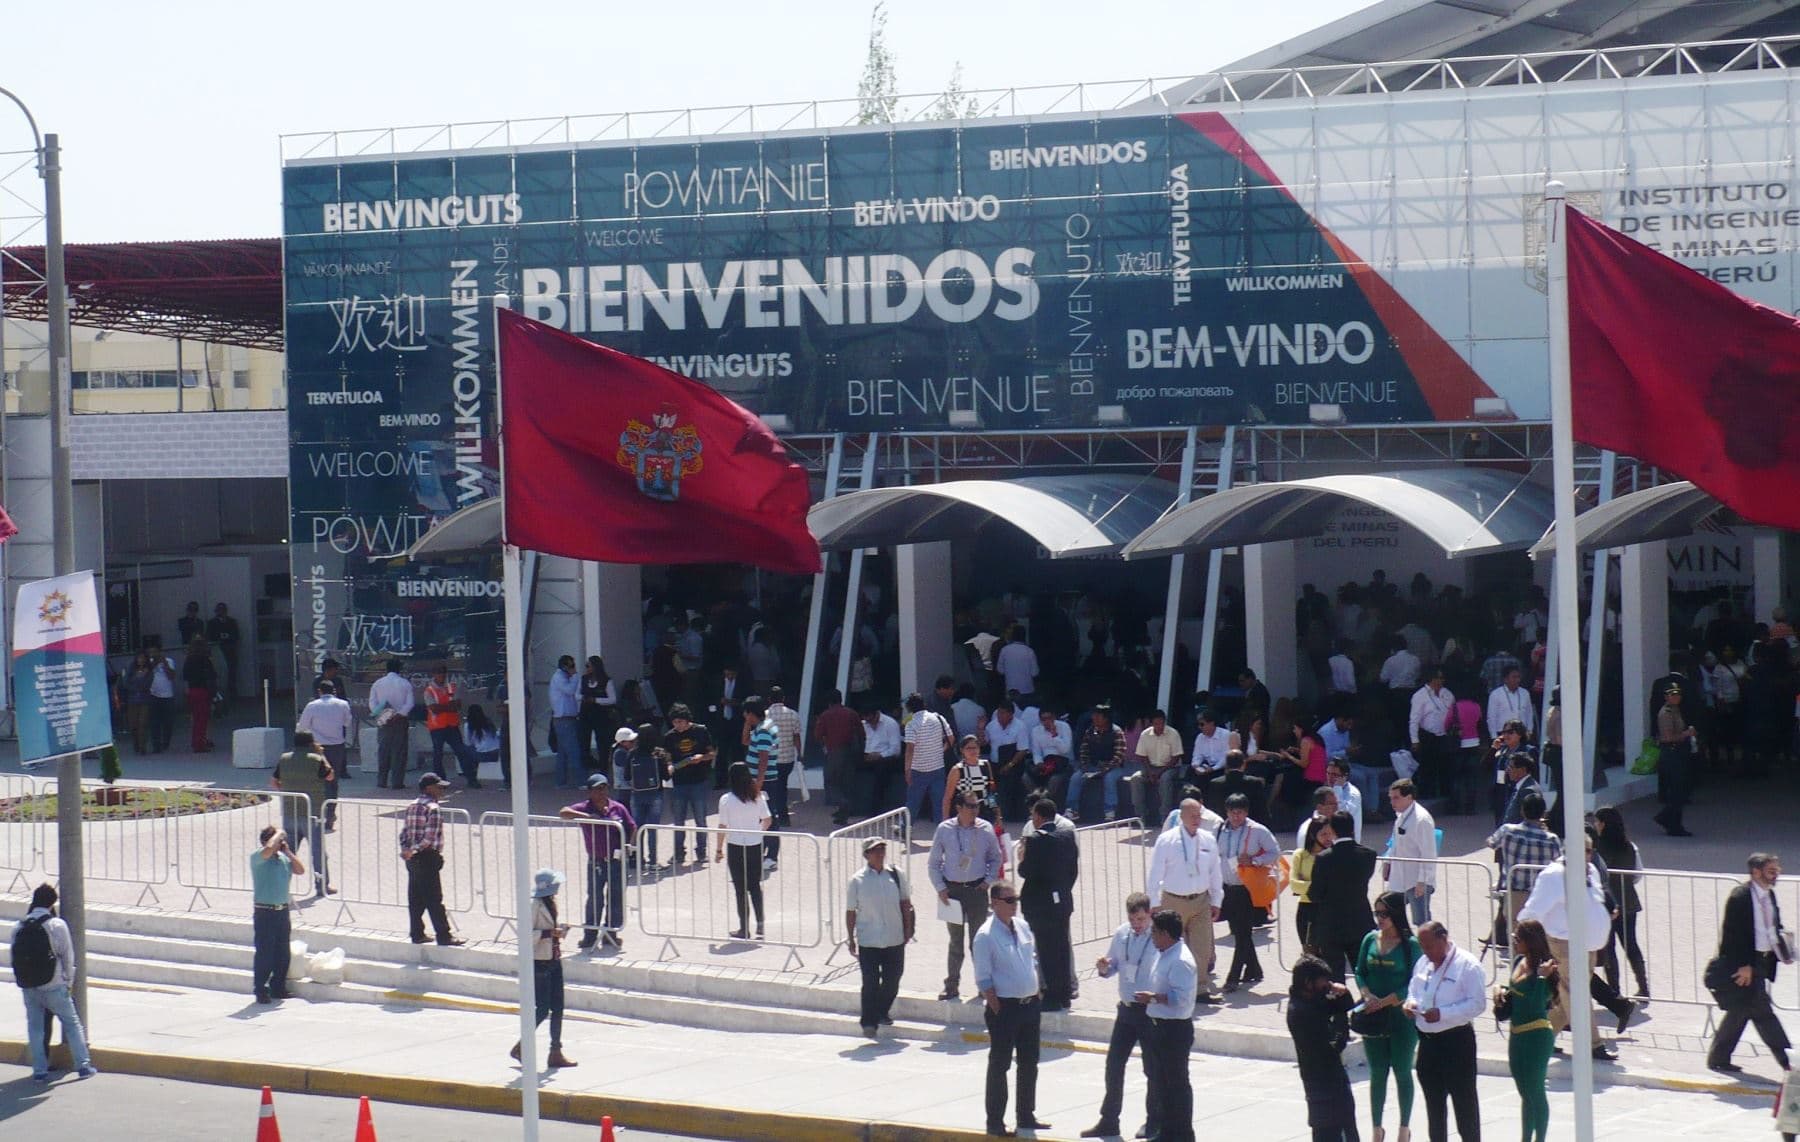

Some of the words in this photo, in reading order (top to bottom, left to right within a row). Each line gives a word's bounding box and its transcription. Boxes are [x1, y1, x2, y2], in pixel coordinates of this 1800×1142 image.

[989, 141, 1147, 170] BIENVENIDOS
[624, 163, 824, 209] POWITANIE
[1619, 183, 1787, 207] INSTITUTO
[323, 193, 523, 232] BENVINGUTS
[854, 194, 1000, 226] BEM-VINDO
[585, 228, 664, 247] WELCOME
[1170, 163, 1191, 306] TERVETULOA
[1620, 216, 1661, 233] DE
[1672, 238, 1777, 258] MINAS
[1115, 252, 1162, 277] 欢迎
[522, 247, 1040, 333] BIENVENIDOS
[1226, 274, 1343, 292] WILLKOMMEN
[1066, 213, 1094, 395] BIENVENUTO
[328, 293, 428, 354] 欢迎
[1127, 321, 1374, 369] BEM-VINDO
[644, 352, 793, 378] NVINGUTS
[451, 257, 483, 503] WILLKOMMEN
[1116, 385, 1156, 400] добро
[1275, 380, 1397, 404] BIENVENUE
[307, 391, 383, 405] TERVETULOA
[848, 375, 1050, 416] BIENVENUE
[379, 413, 441, 427] BEM-VINDO
[308, 450, 432, 478] WELCOME
[312, 515, 441, 554] POWIT
[1313, 537, 1345, 548] DEL
[397, 578, 504, 598] BIENVENIDO
[312, 564, 326, 679] ENVINGUTS
[341, 613, 415, 656] 欢迎
